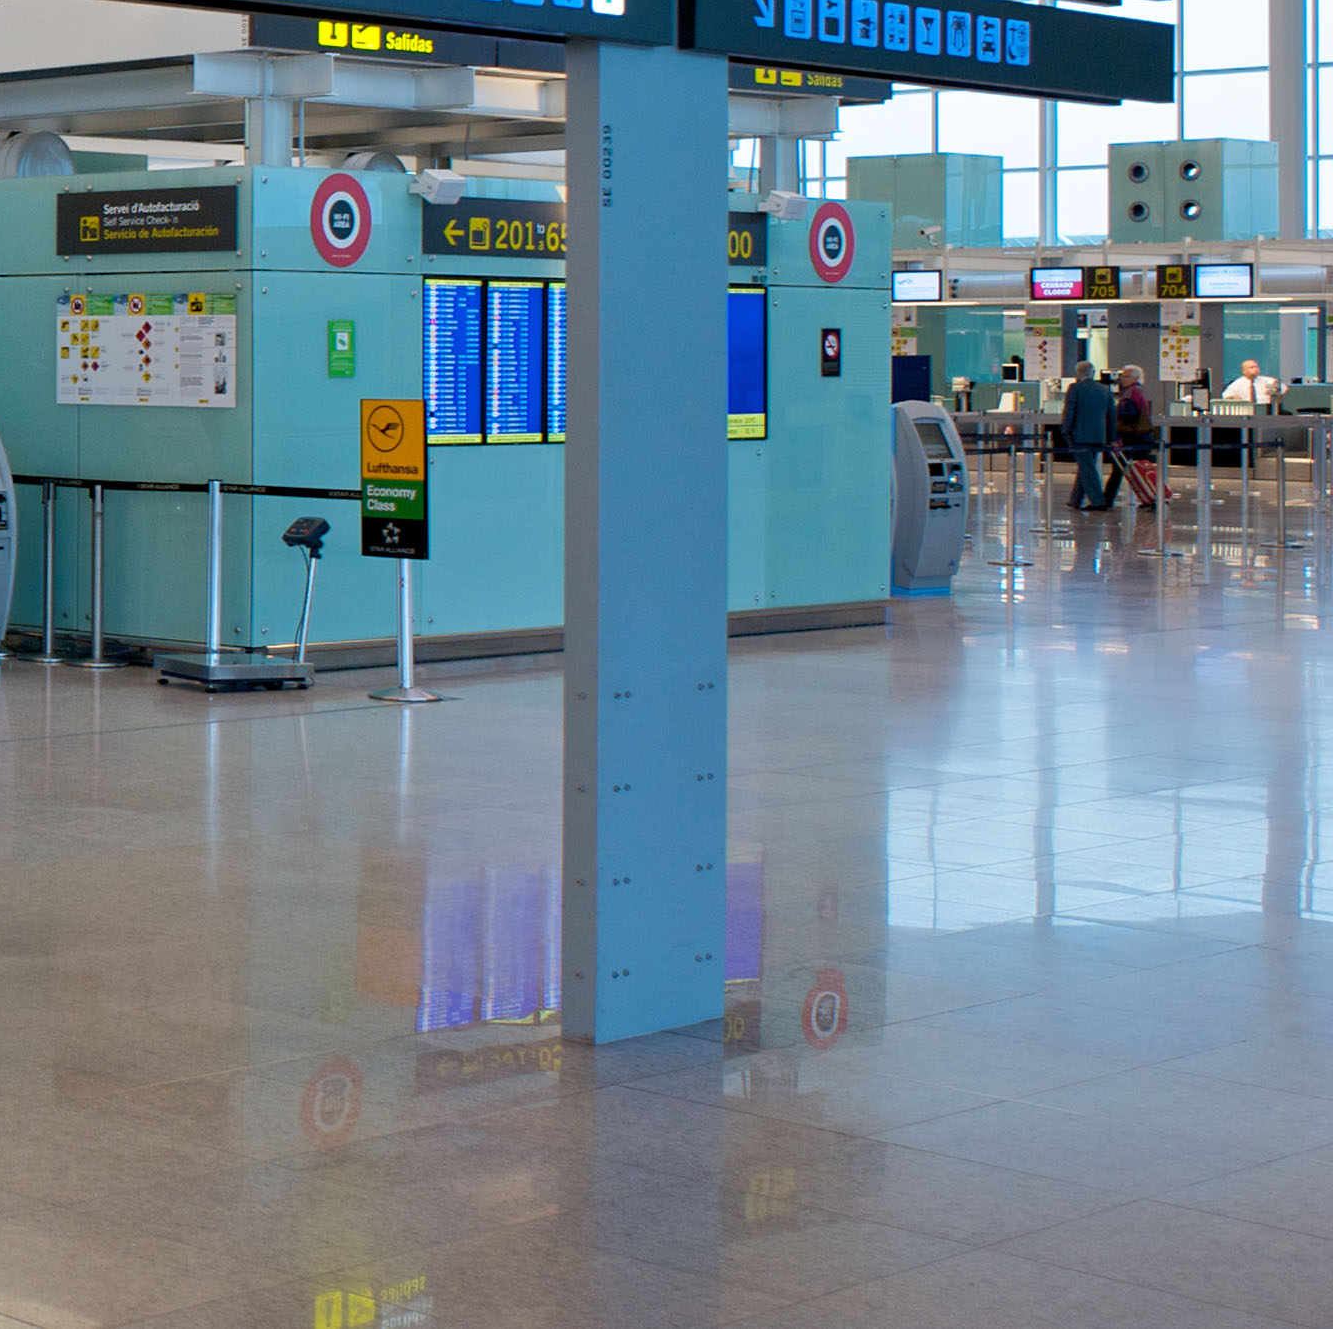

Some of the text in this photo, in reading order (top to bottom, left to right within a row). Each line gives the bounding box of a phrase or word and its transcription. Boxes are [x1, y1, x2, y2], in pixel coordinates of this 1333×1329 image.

[385, 31, 433, 54] Salidas
[806, 73, 843, 88] Salidas
[103, 203, 130, 215] Servei
[103, 216, 117, 226] Self
[118, 216, 145, 226] Service
[104, 225, 220, 240] Servicio de Autofacturación
[495, 220, 535, 250] 201
[1091, 286, 1116, 298] 705
[1160, 285, 1188, 296] 704
[367, 463, 418, 475] Lufthansa
[367, 484, 417, 501] Economy
[367, 499, 396, 512] Class
